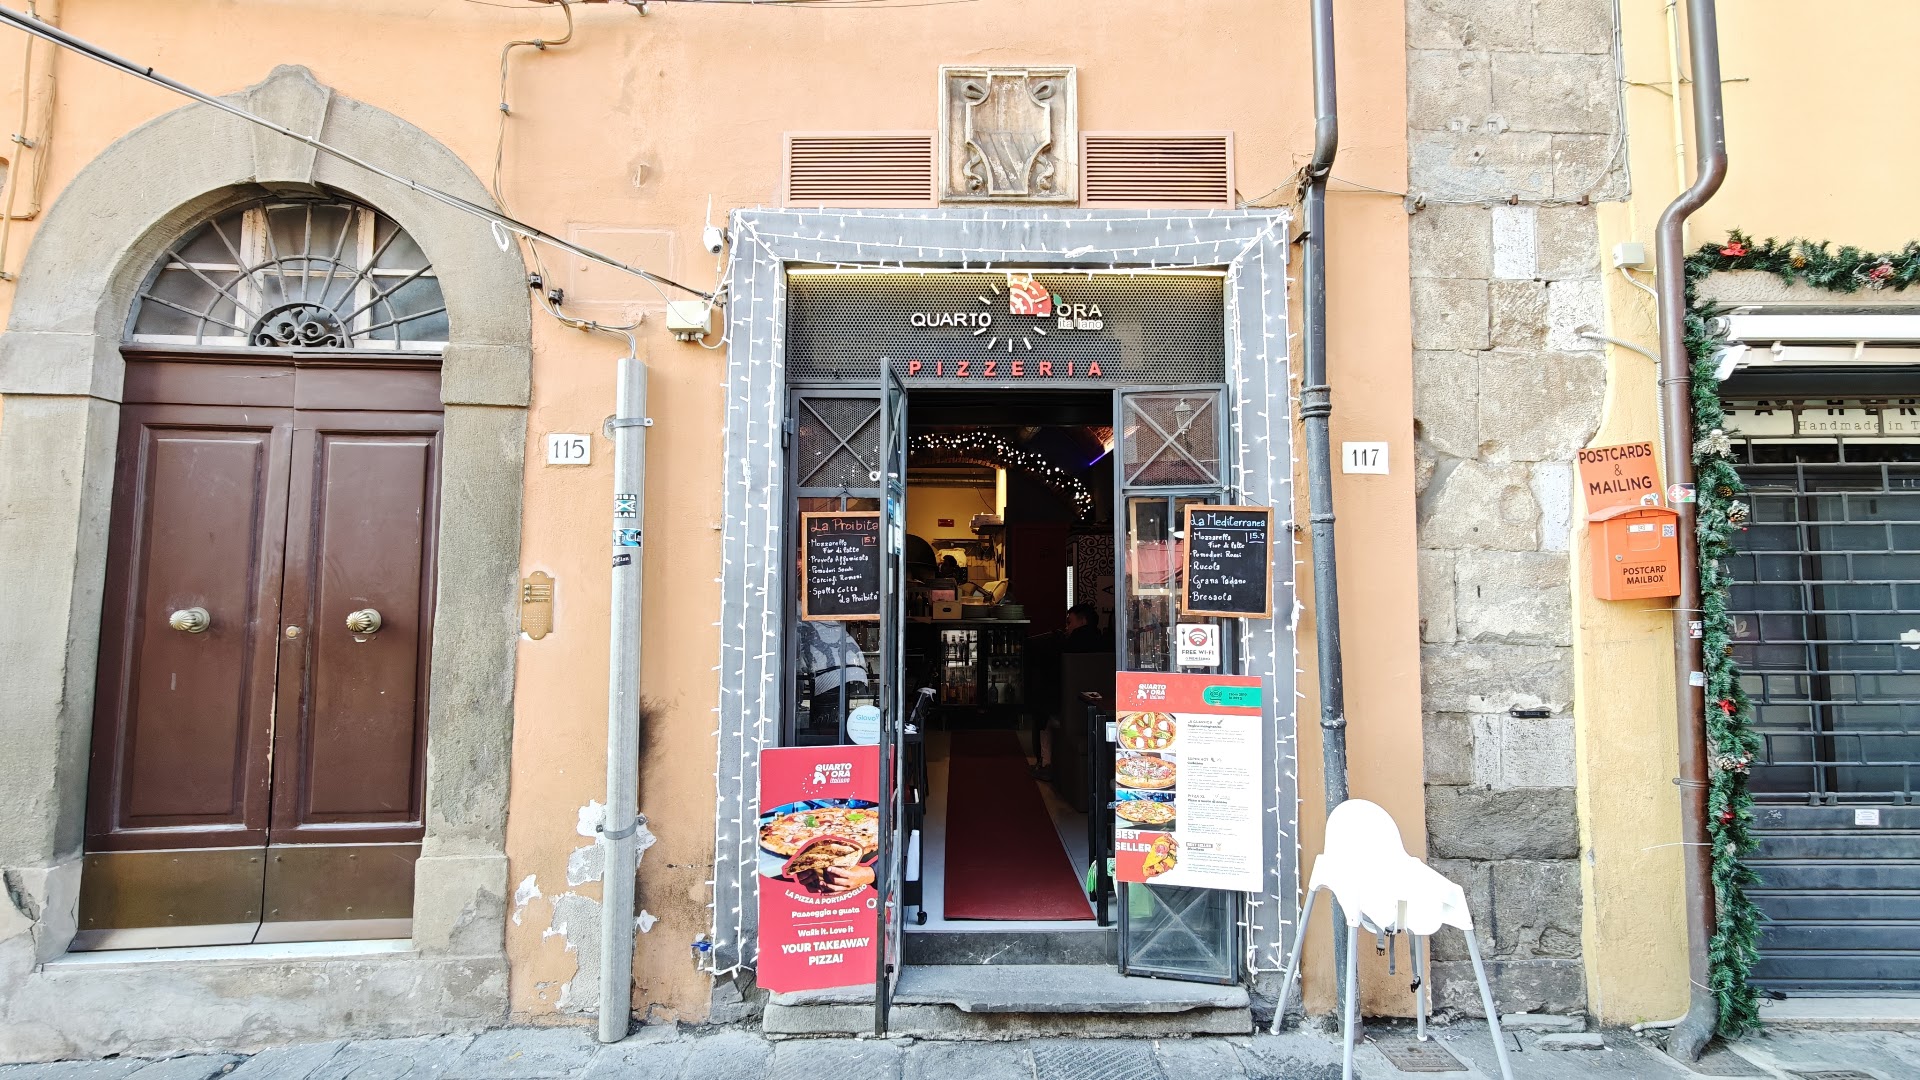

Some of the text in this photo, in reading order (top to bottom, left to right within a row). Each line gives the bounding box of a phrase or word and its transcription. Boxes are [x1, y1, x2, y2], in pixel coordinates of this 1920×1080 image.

[910, 311, 992, 328] QUARTO
[1058, 318, 1104, 330] italiano
[909, 361, 1103, 376] PIZZERIA
[1799, 420, 1881, 431] Handmade
[1888, 420, 1902, 431] in
[553, 439, 585, 459] 115
[1578, 443, 1652, 464] POSTCARDS
[1352, 448, 1379, 467] 117
[1614, 463, 1623, 476] &
[1589, 475, 1653, 496] MAILING
[811, 518, 879, 532] La Proibita
[1190, 513, 1266, 527] La Mediterranea
[1193, 561, 1220, 571] Rucola
[1622, 565, 1667, 575] POSTCARD
[1192, 574, 1247, 589] Grana Padano
[1626, 574, 1664, 585] MAILBOX
[1192, 591, 1232, 601] Bresaola
[815, 763, 852, 773] QUARTO
[1116, 830, 1140, 840] BEST
[1116, 842, 1151, 852] SELLER
[785, 889, 794, 899] LA
[794, 894, 814, 905] PIZZA
[821, 883, 867, 905] PORTAFOGLIO
[792, 908, 831, 918] Passeggia
[838, 907, 860, 917] gusta
[798, 925, 854, 937] Walk it. Love it
[781, 937, 870, 955] YOUR TAKEAWAY
[808, 954, 844, 966] PIZZA!
